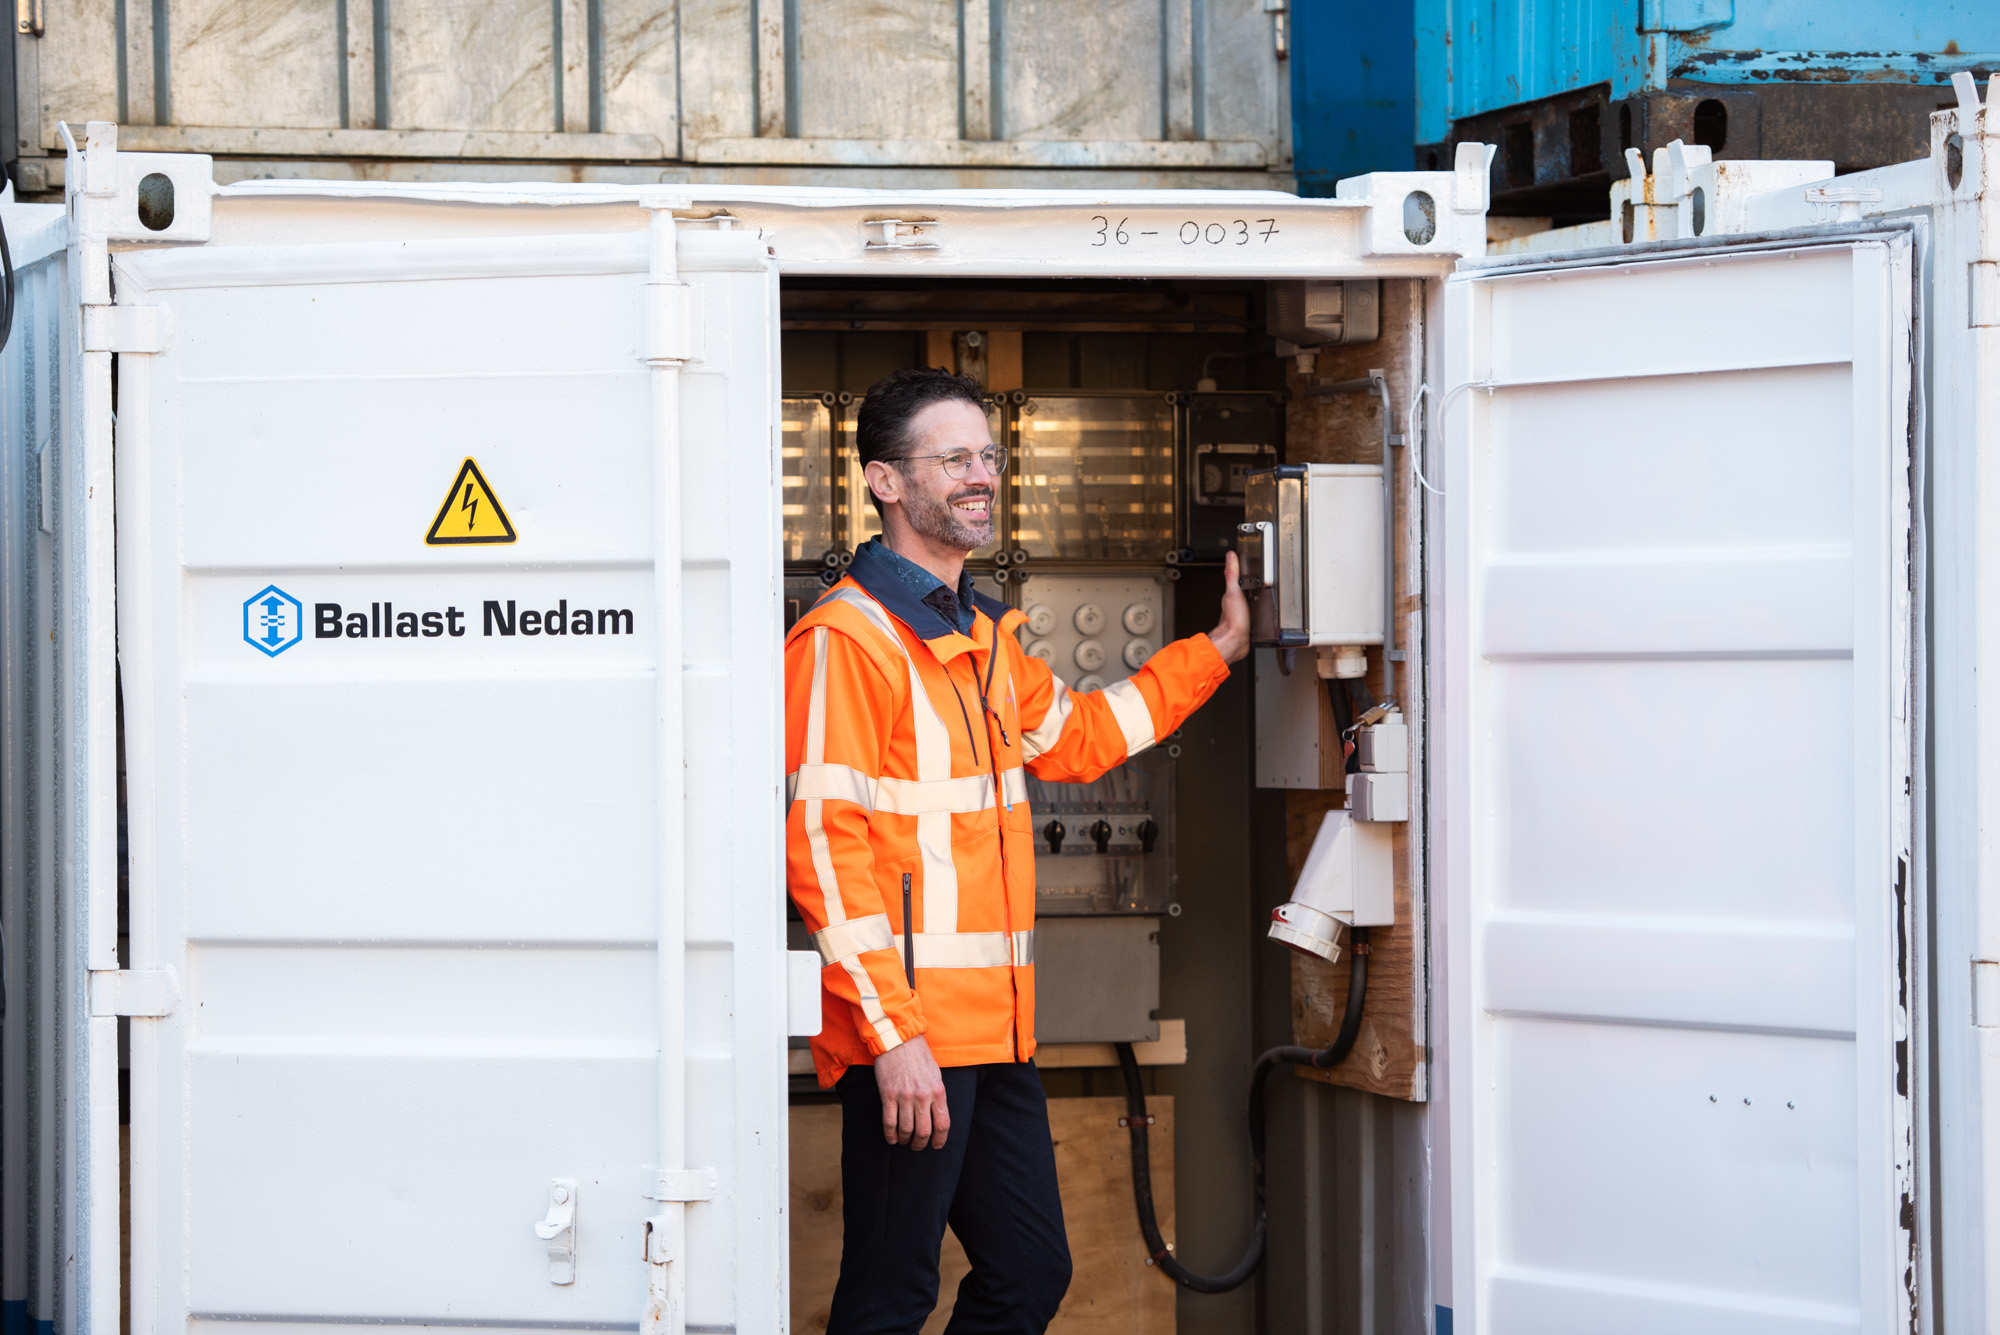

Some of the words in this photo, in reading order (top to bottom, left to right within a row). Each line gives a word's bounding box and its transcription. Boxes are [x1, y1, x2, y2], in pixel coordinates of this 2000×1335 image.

[1180, 219, 1279, 245] 0037
[315, 603, 465, 638] Ballast
[484, 600, 633, 636] Nedam
